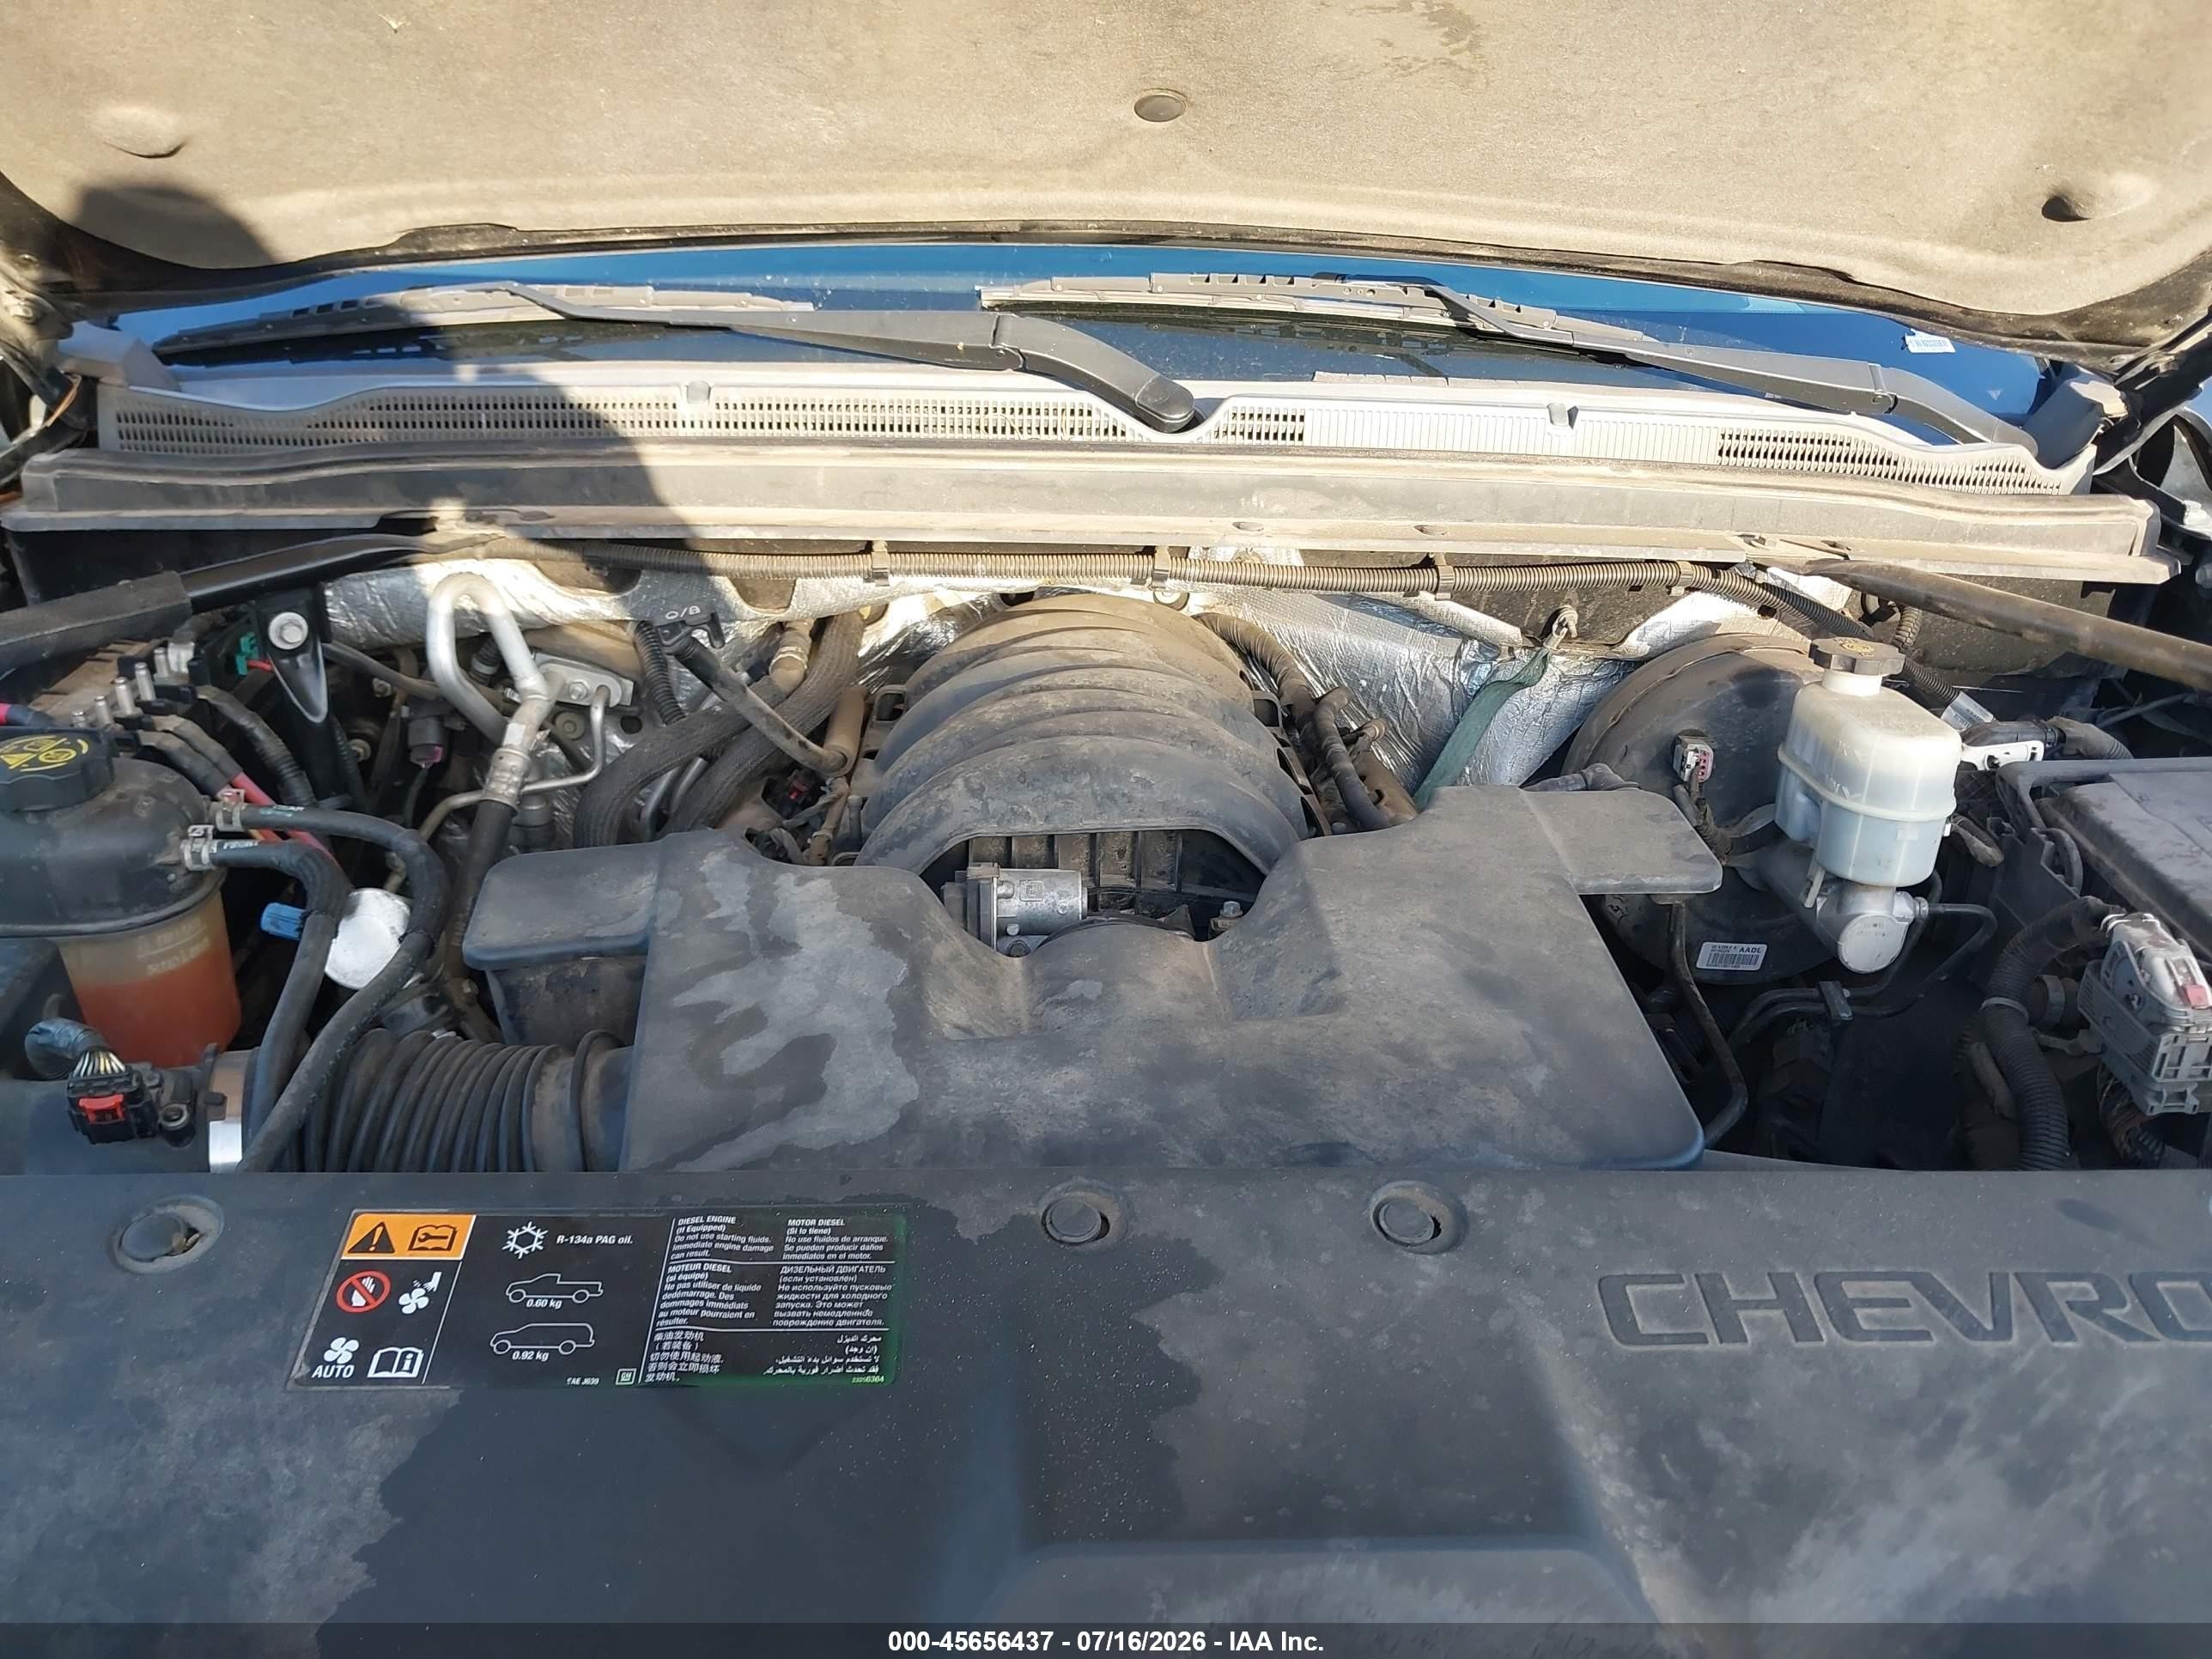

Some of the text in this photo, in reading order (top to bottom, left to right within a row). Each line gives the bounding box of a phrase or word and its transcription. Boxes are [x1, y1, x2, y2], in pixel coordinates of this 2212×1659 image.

[678, 1215, 736, 1226] DIESEL ENGINE
[556, 1235, 592, 1243] R-134a
[716, 1233, 746, 1243] starting
[714, 1243, 740, 1251] engine
[743, 1244, 774, 1253] damage
[667, 1263, 732, 1273] MOTEUR DIESEL
[780, 1265, 886, 1274] ДИЗЕЛЬНЫЙ ДВИГАТЕЛЬ
[677, 1282, 690, 1291] pas
[693, 1279, 720, 1290] utiliser
[526, 1298, 562, 1309] 0.60 kg
[660, 1300, 749, 1309] dommages immédiats
[701, 1310, 743, 1319] pourraient
[513, 1351, 549, 1361] 0.92 kg
[312, 1364, 354, 1378] AUTO
